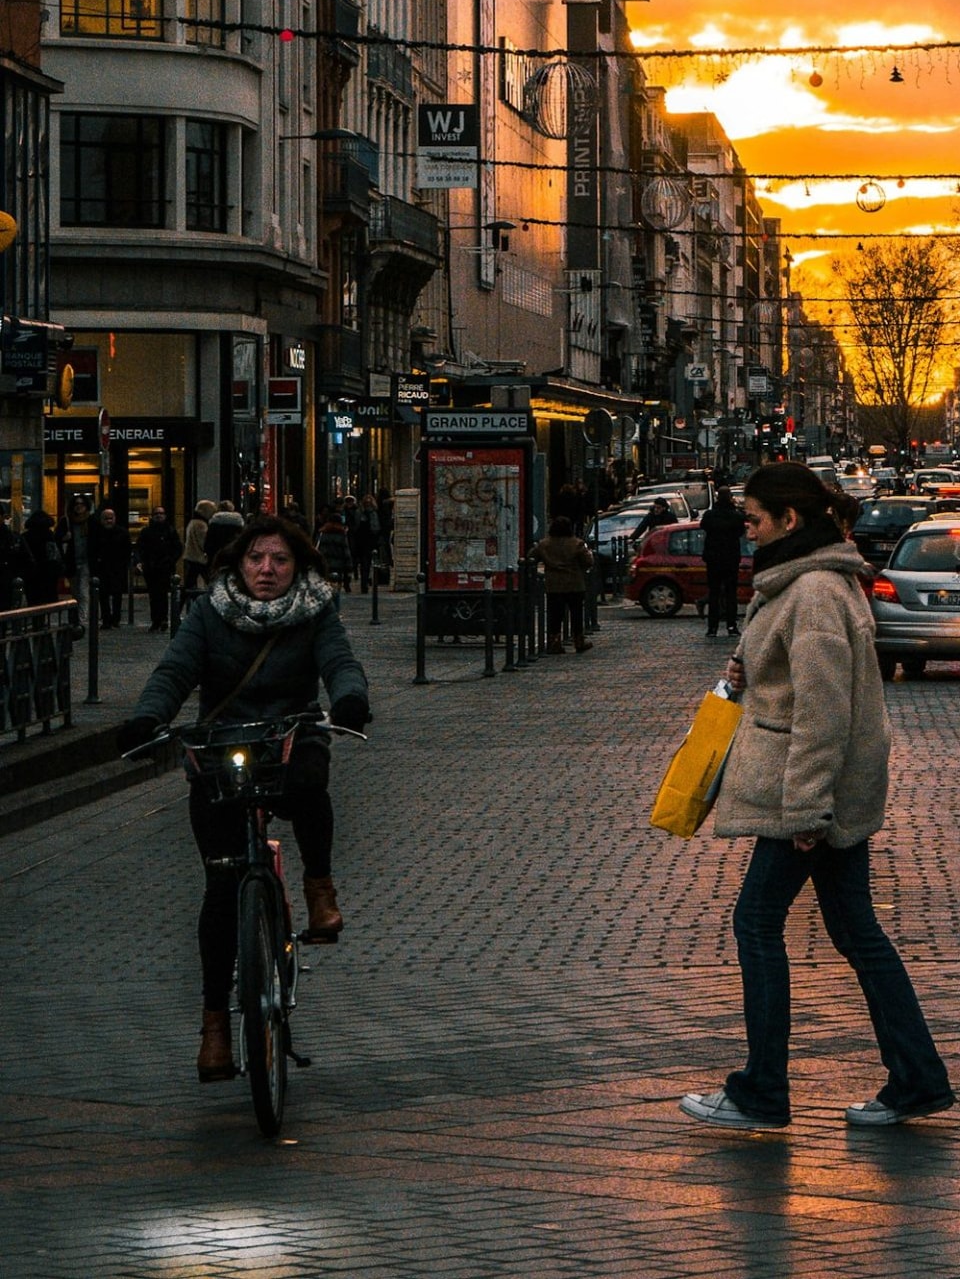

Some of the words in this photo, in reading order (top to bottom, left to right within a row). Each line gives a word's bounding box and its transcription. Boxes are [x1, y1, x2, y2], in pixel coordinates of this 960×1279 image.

[427, 111, 465, 133] WJ
[431, 133, 460, 141] INVEST
[5, 352, 43, 360] BANQUE
[5, 360, 43, 368] POSTALE
[398, 383, 424, 391] PIERRE
[398, 391, 428, 400] RICAUD
[358, 403, 389, 415] unik
[430, 417, 478, 428] GRAND
[482, 417, 527, 428] PLACE
[44, 430, 83, 440] CIETE
[109, 429, 164, 440] ENERALE
